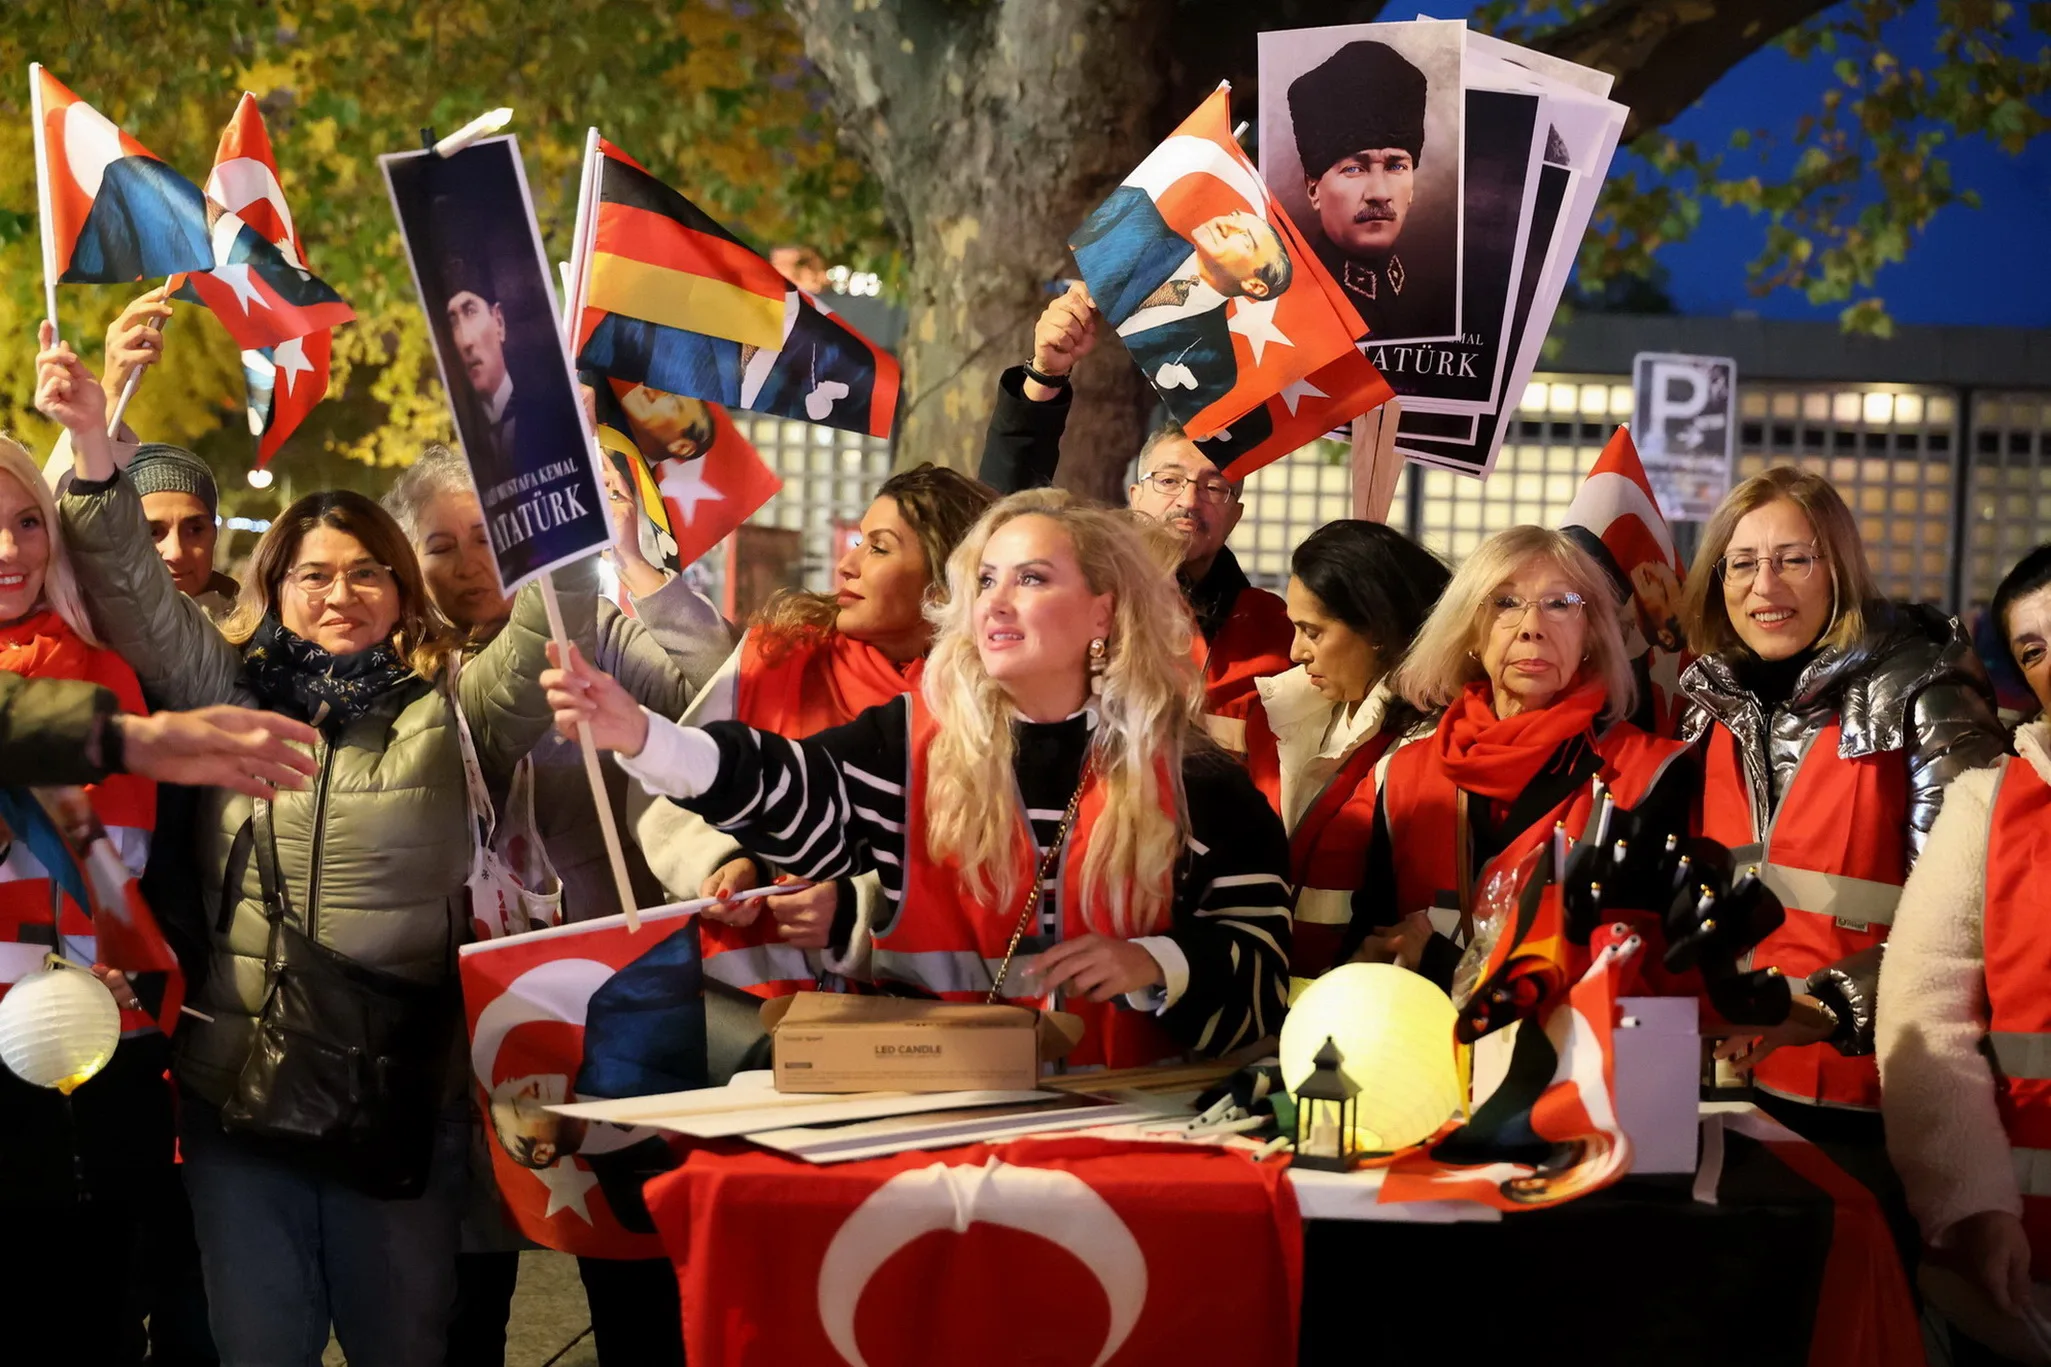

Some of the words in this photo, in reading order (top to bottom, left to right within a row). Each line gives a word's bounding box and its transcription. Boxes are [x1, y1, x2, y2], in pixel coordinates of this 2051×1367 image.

[1455, 332, 1484, 346] MAL
[1366, 344, 1479, 378] ATÜRK
[1652, 363, 1710, 458] P
[538, 457, 579, 483] KEMAL
[493, 483, 589, 554] ATATÜRK
[875, 1045, 896, 1054] LED
[899, 1045, 942, 1054] CANDLE
